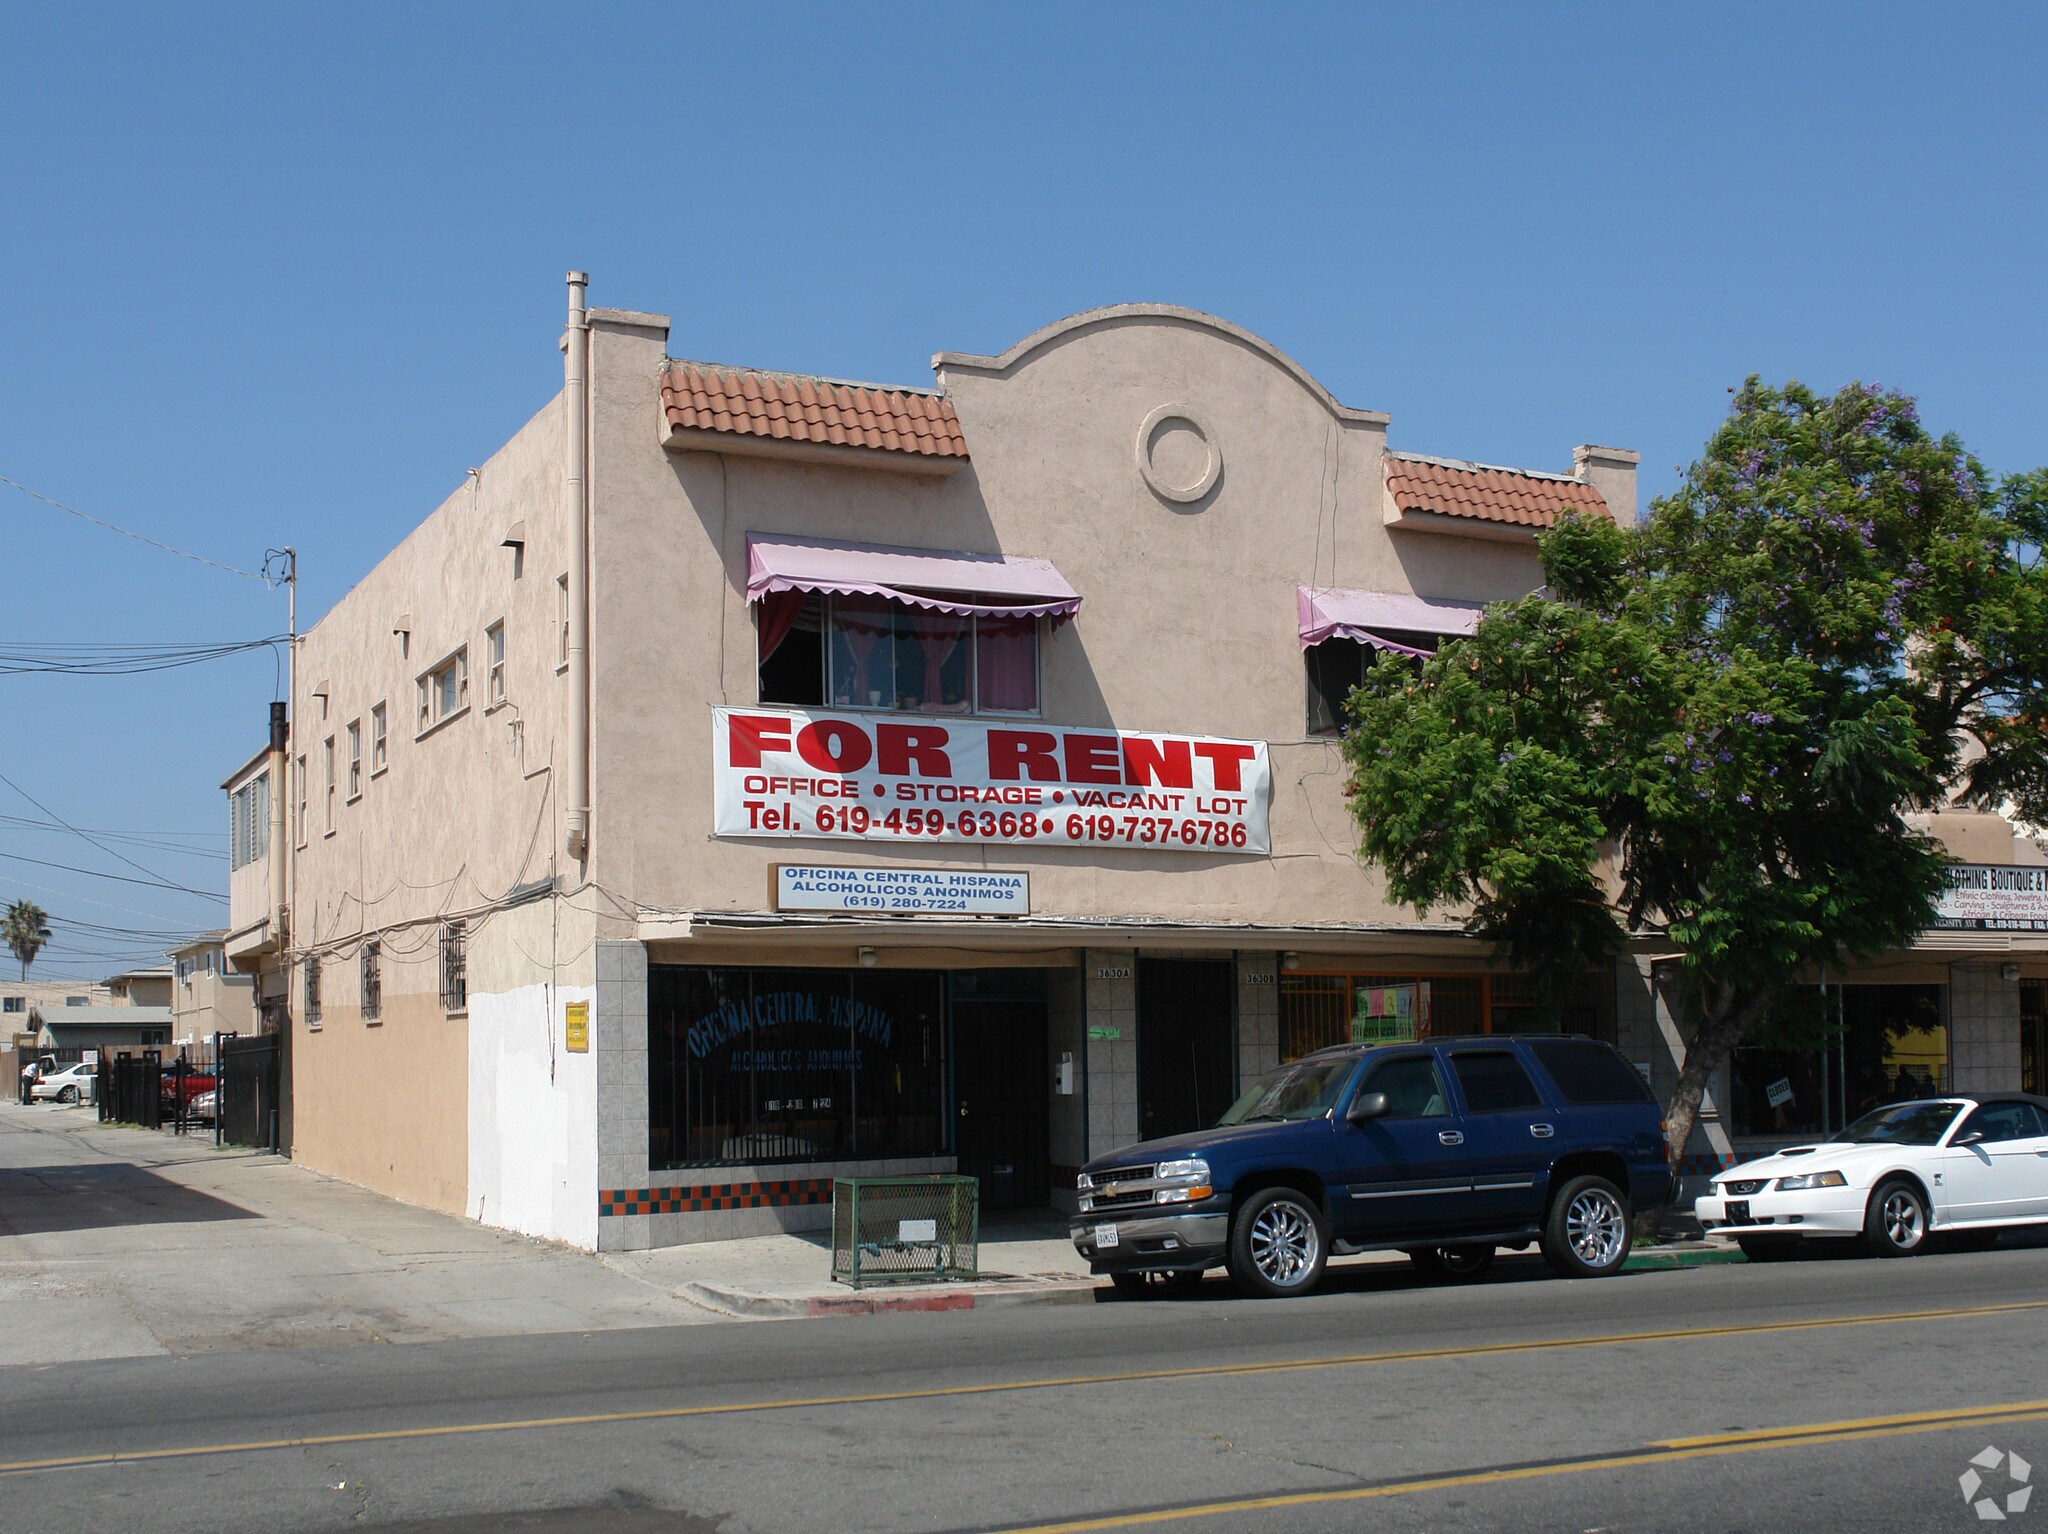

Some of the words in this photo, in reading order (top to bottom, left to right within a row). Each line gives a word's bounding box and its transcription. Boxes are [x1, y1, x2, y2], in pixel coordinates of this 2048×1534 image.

[729, 714, 952, 778] FOR
[987, 729, 1255, 791] RENT
[743, 775, 859, 798] OFFICE
[896, 783, 1042, 805] STORAGE
[1070, 789, 1185, 811] VACANT
[1196, 796, 1248, 815] LOT
[743, 800, 801, 831] Tel.
[815, 805, 1037, 838] 619-459-6368
[1065, 815, 1248, 848] 619-737-6786
[785, 867, 858, 881] OFICINA
[863, 872, 944, 885] CENTRAL
[949, 876, 1022, 888] HISPANA
[1990, 868, 2033, 891] BOUTIQUE
[2035, 872, 2042, 891] &
[792, 881, 918, 896] ALCOHOLICOS
[923, 887, 1015, 900] ANONIMOS
[843, 895, 886, 909] (619)
[891, 897, 967, 910] 280-7224
[1954, 900, 1985, 911] Carving
[1991, 902, 2029, 911] Sculptures
[1962, 910, 1990, 919] African
[1099, 969, 1129, 977] 3630A
[1768, 1080, 1789, 1098] CLOSED
